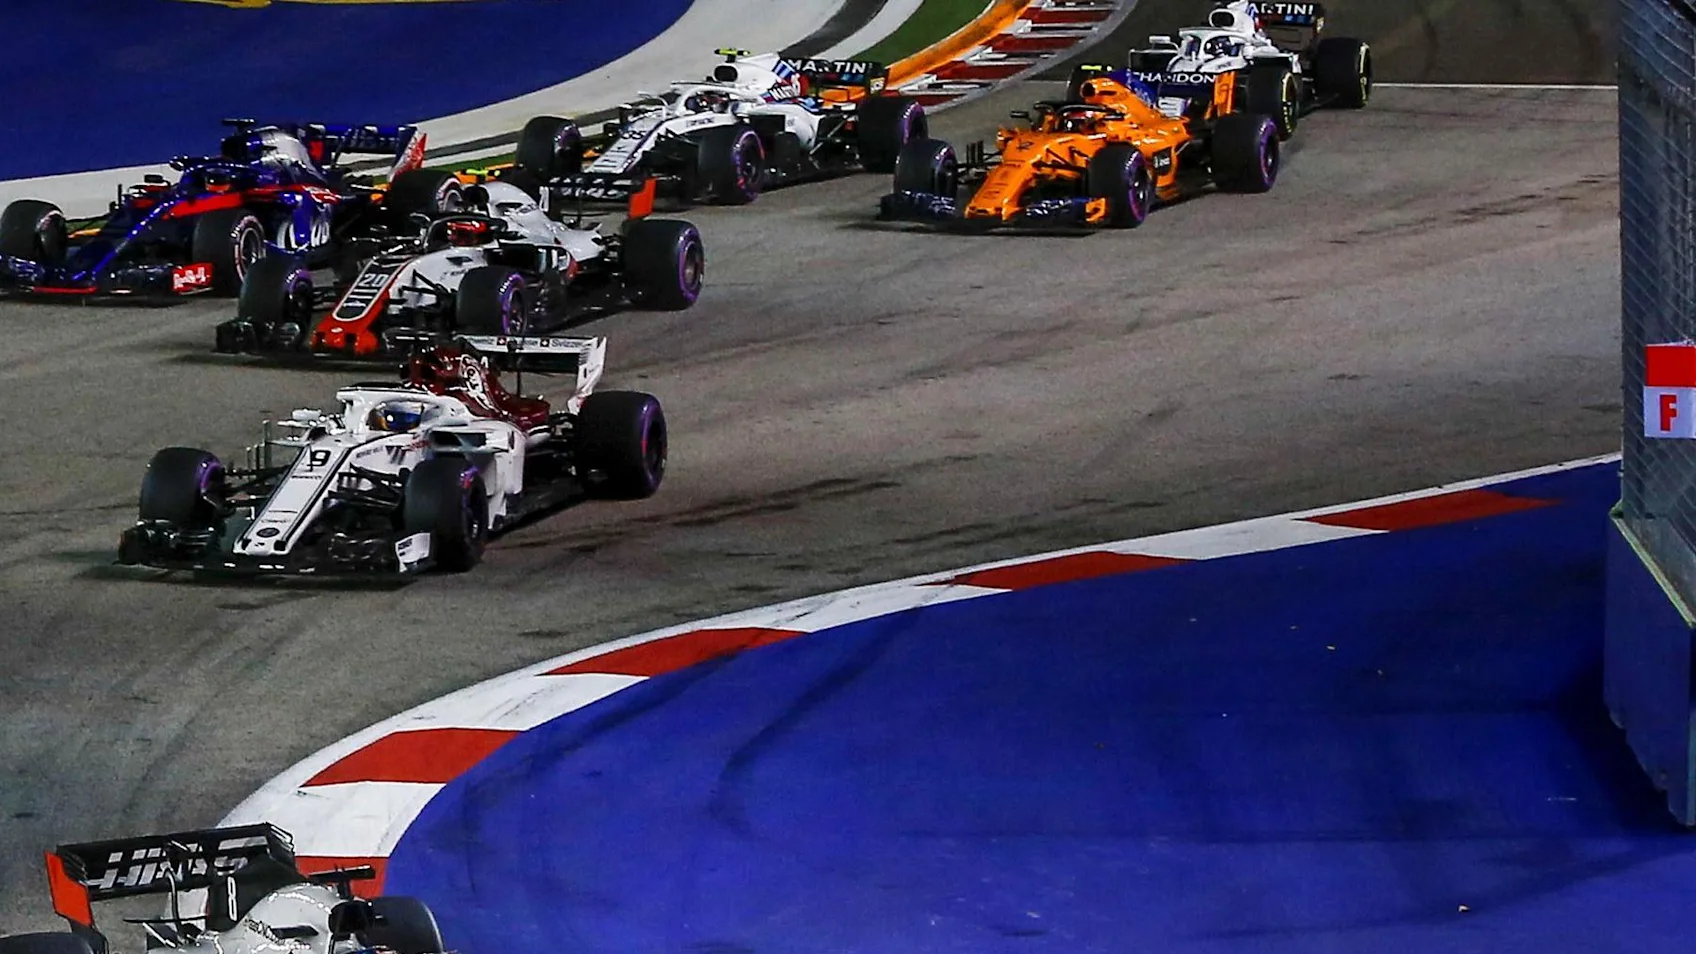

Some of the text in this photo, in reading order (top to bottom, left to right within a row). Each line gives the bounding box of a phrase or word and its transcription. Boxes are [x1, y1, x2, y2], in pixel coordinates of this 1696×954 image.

[358, 273, 390, 287] 20
[1659, 394, 1678, 432] F
[309, 450, 332, 467] 9
[226, 876, 238, 921] 8
